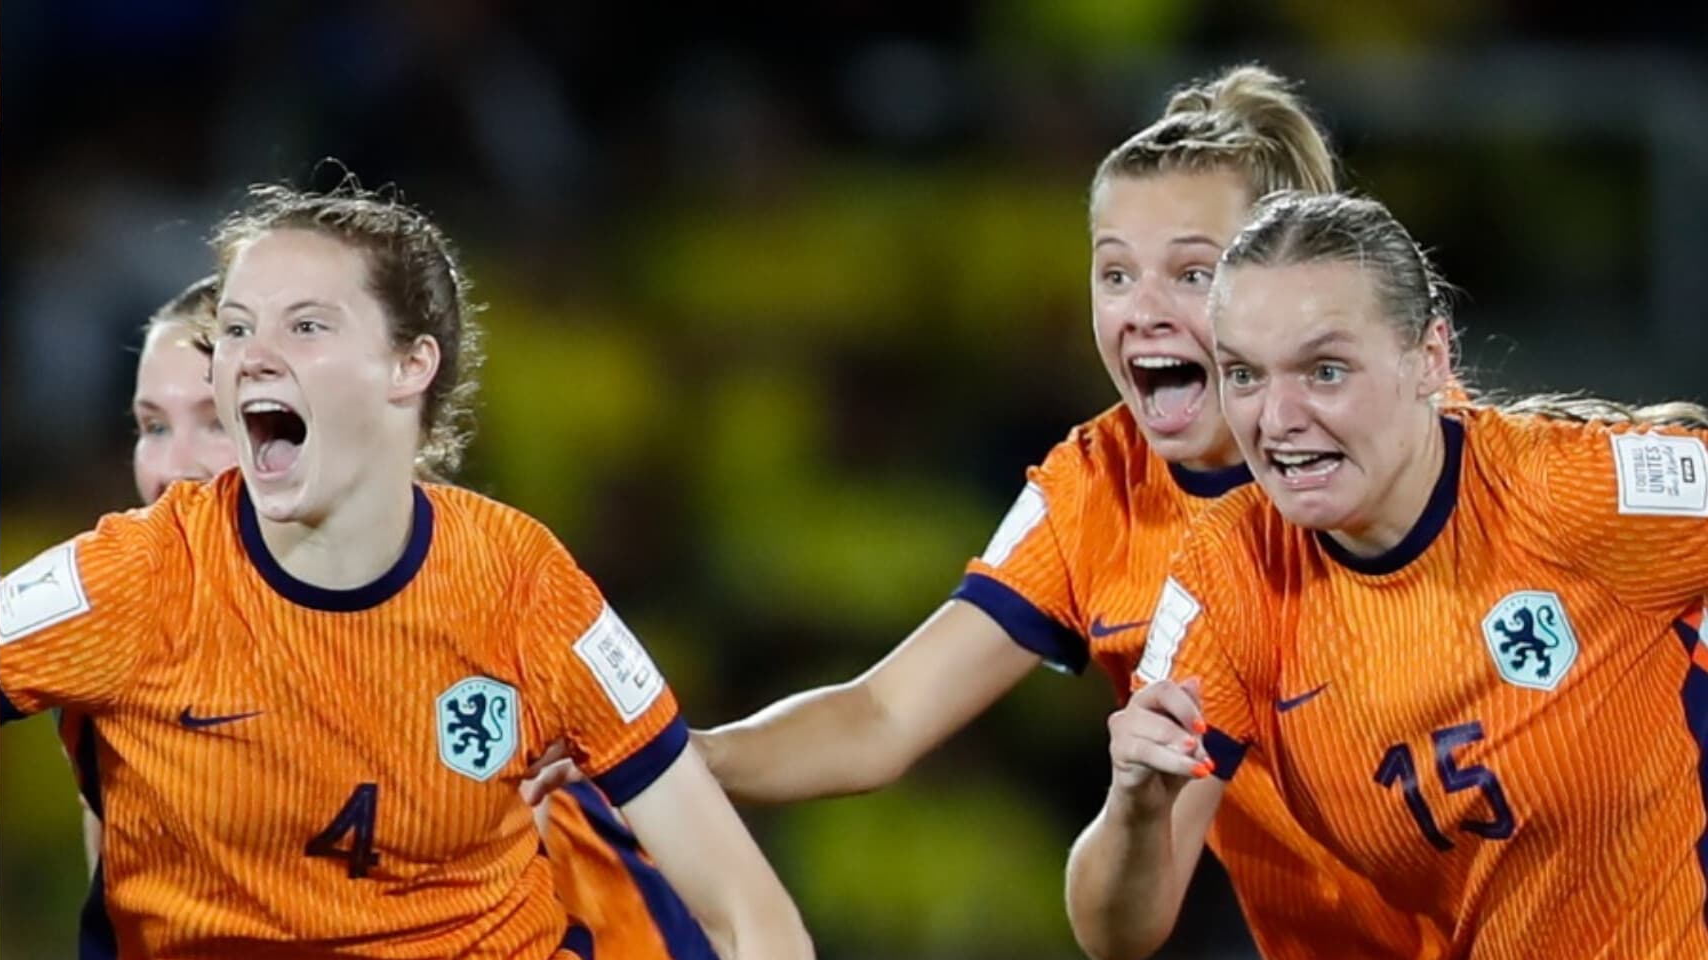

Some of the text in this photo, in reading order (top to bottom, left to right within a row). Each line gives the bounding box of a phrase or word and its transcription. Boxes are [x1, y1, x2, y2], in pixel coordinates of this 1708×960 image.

[1645, 445, 1665, 493] UNITES
[303, 783, 381, 880] 4
[1374, 720, 1515, 852] 15
